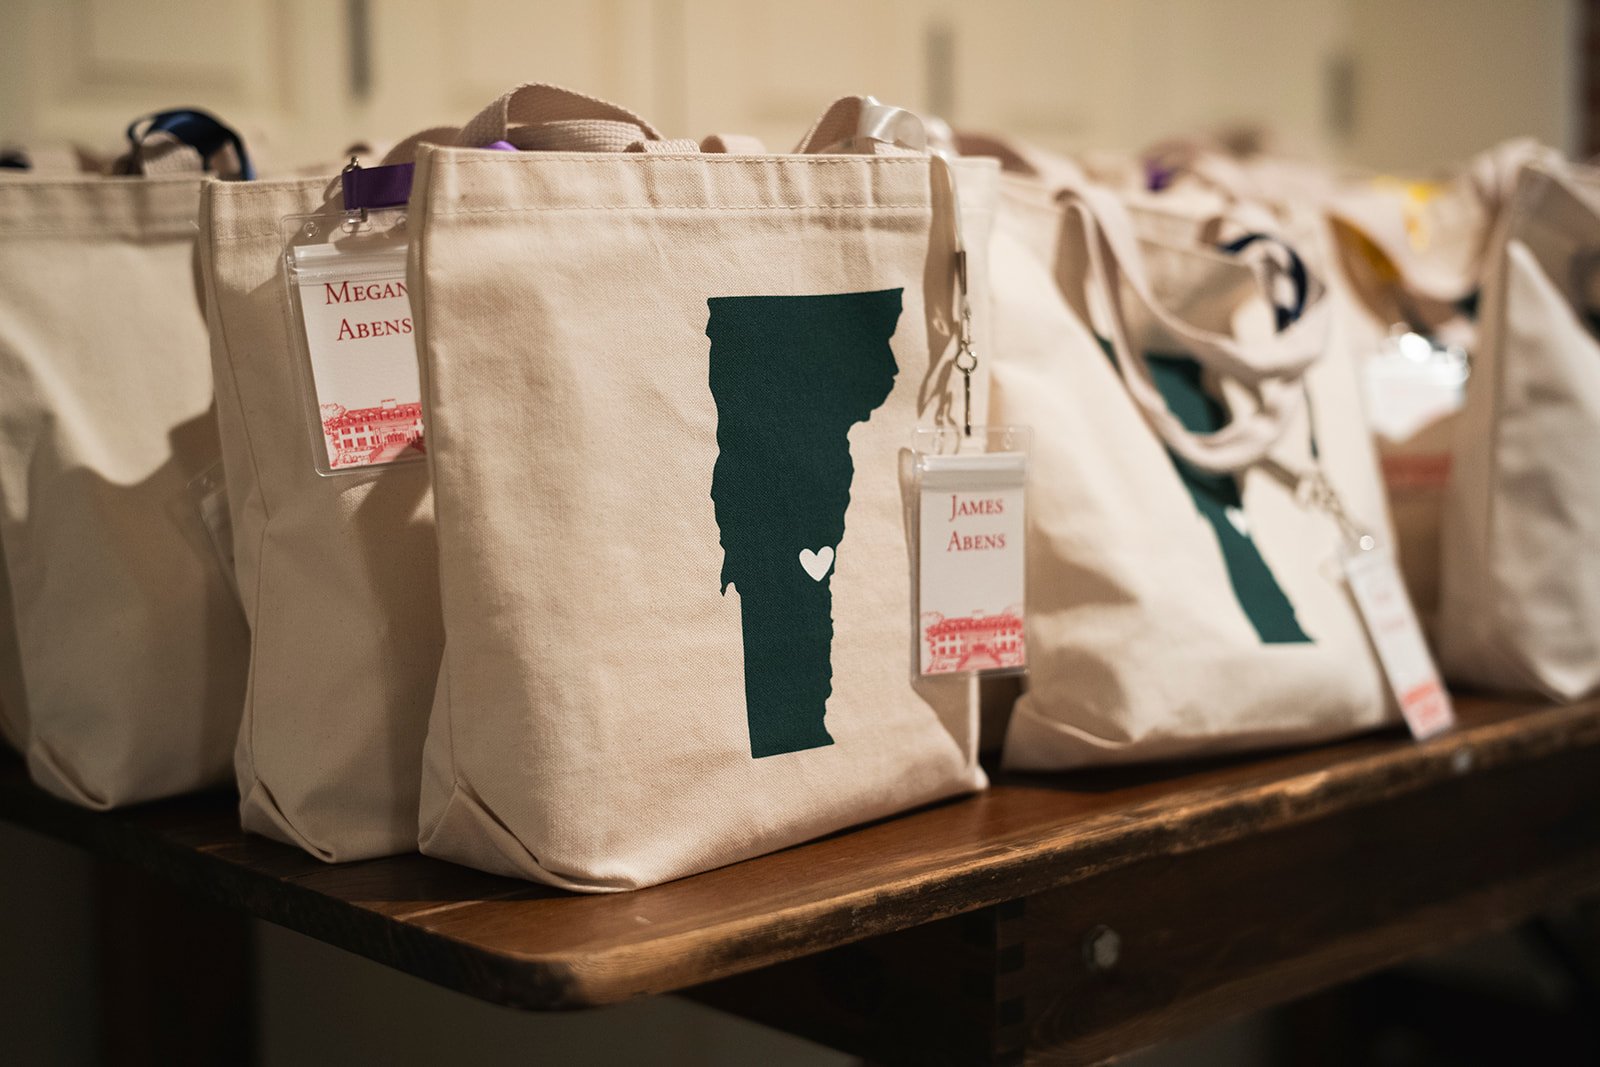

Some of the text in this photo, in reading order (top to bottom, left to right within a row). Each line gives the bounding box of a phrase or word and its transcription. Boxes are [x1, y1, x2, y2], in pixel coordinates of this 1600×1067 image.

[337, 317, 413, 341] ABENS
[949, 494, 1004, 522] JAMES
[947, 530, 1006, 551] ABENS
